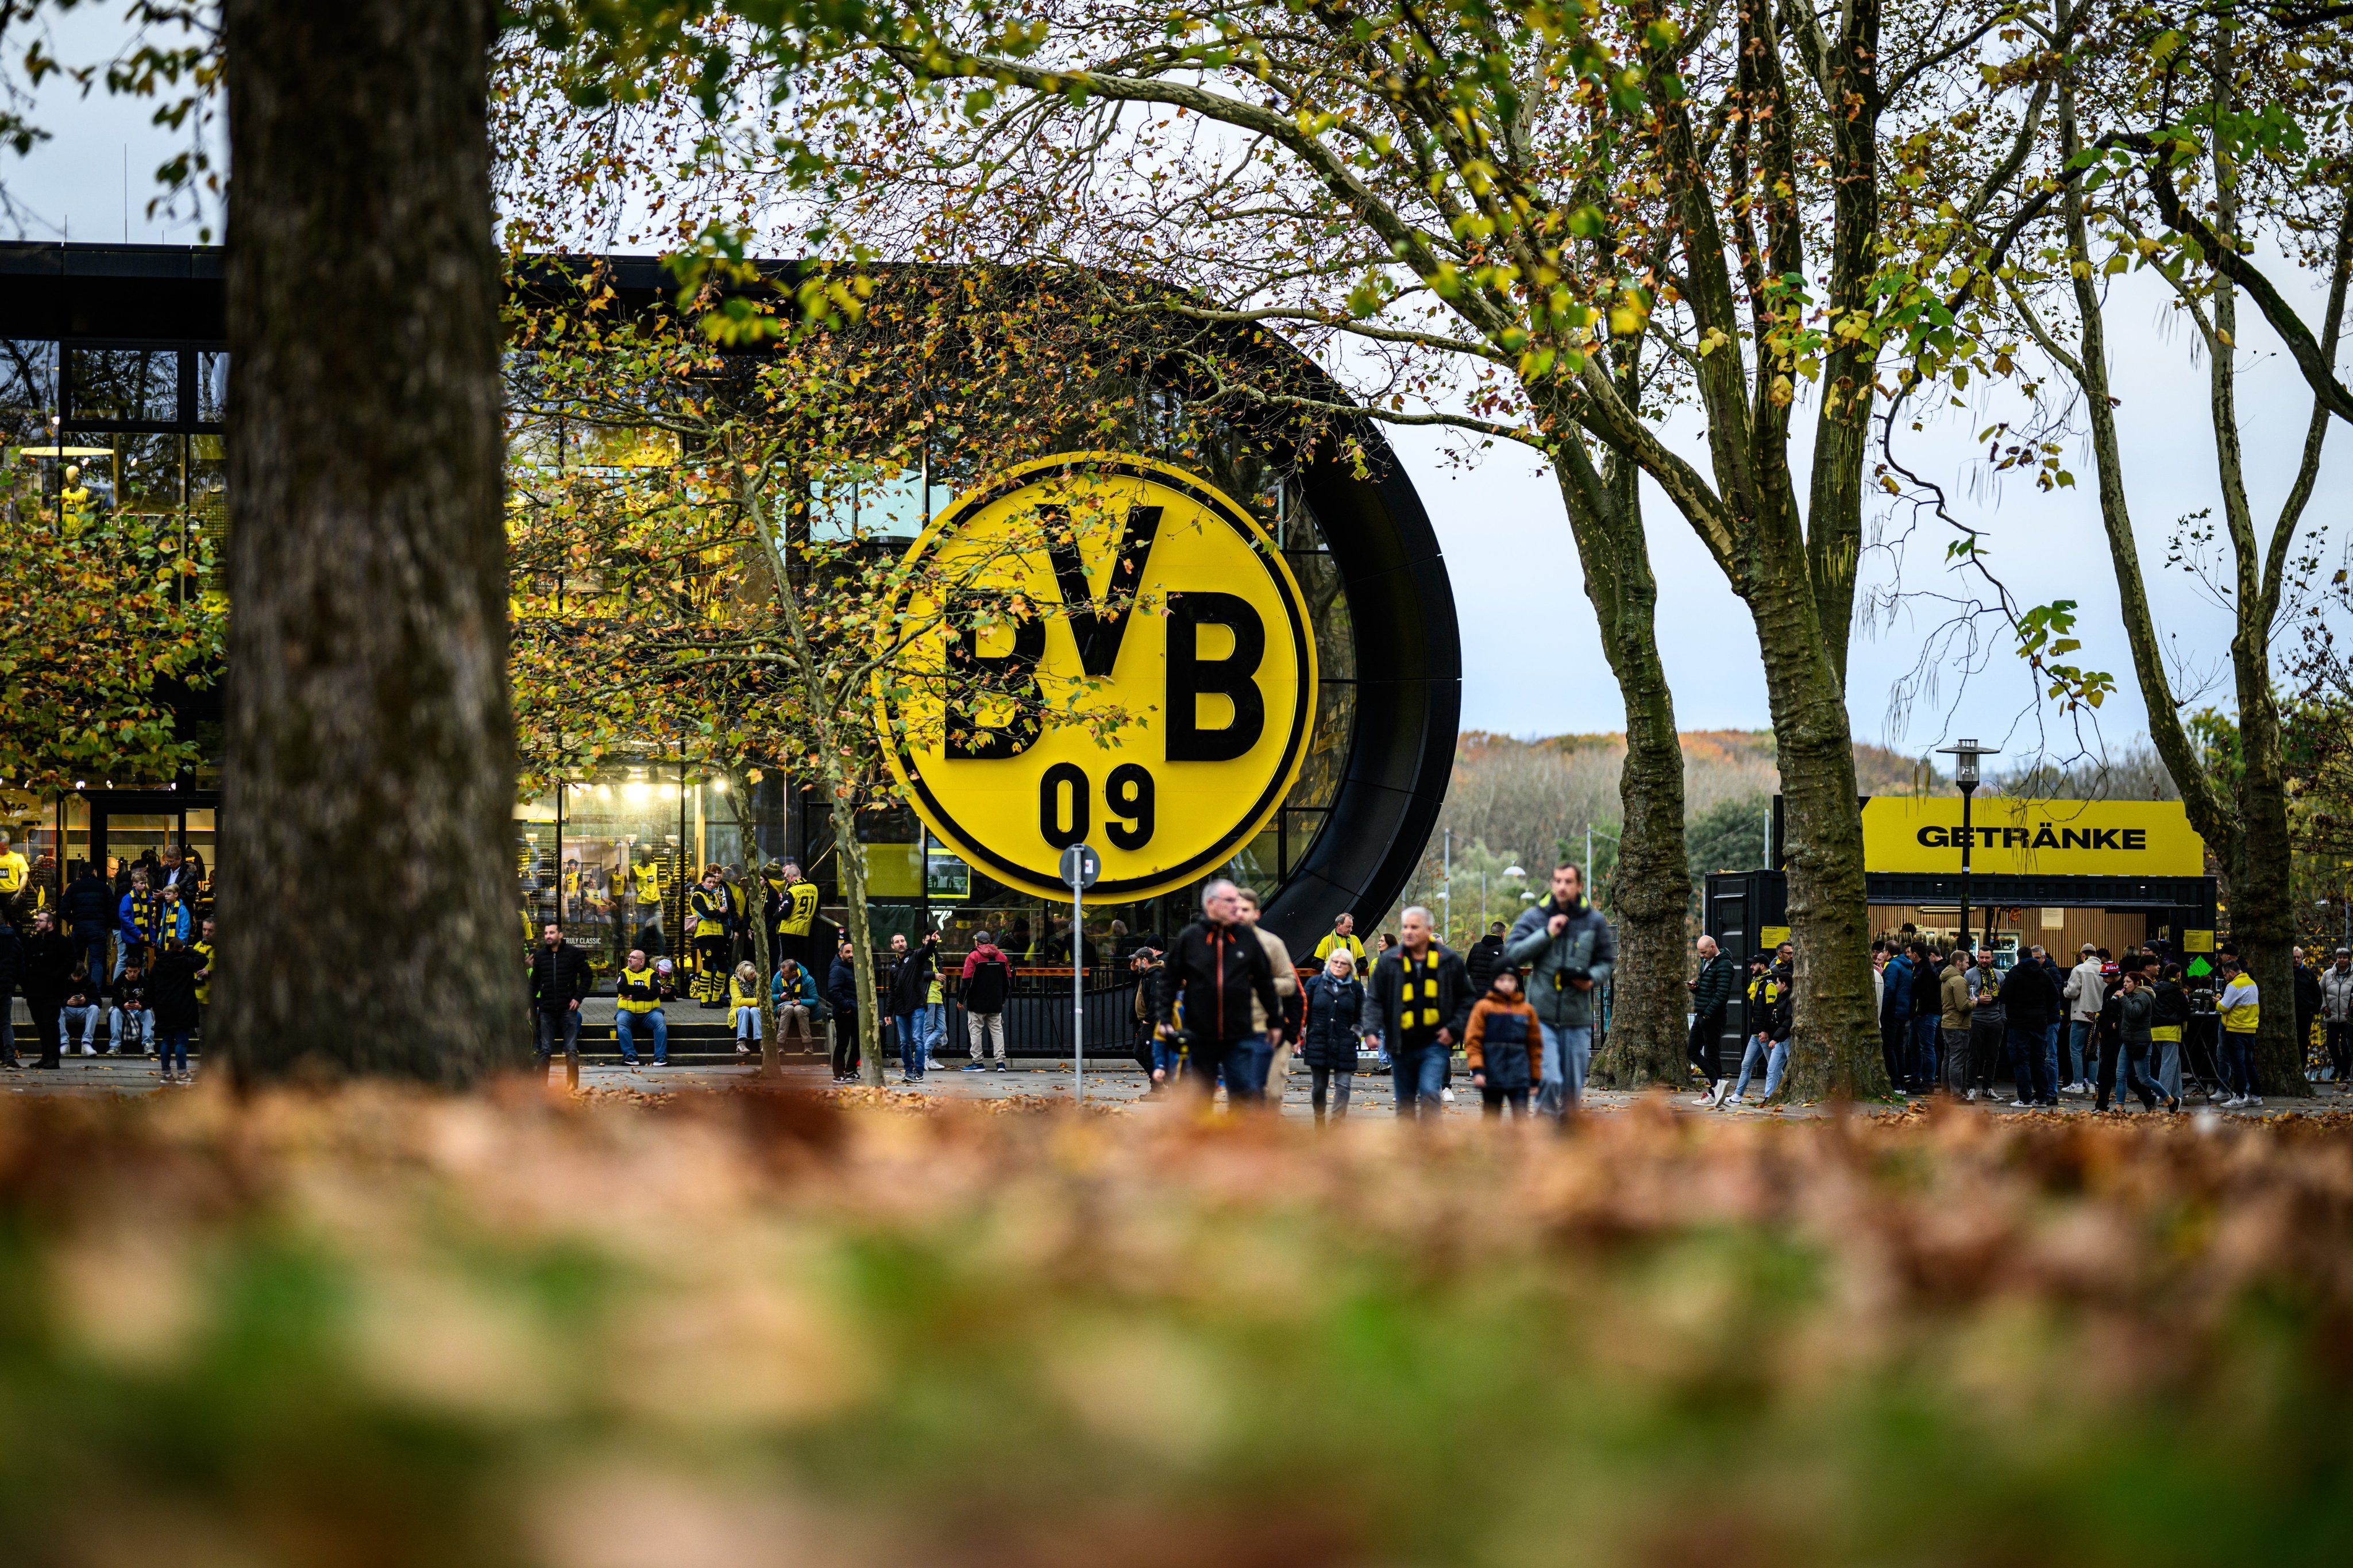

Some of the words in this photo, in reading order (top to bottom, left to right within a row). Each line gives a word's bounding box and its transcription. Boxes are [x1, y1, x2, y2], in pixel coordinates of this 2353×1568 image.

[944, 505, 1266, 762] BVB
[1039, 762, 1155, 851] 09
[1916, 822, 2146, 850] GETRÄNKE
[797, 895, 814, 915] 91
